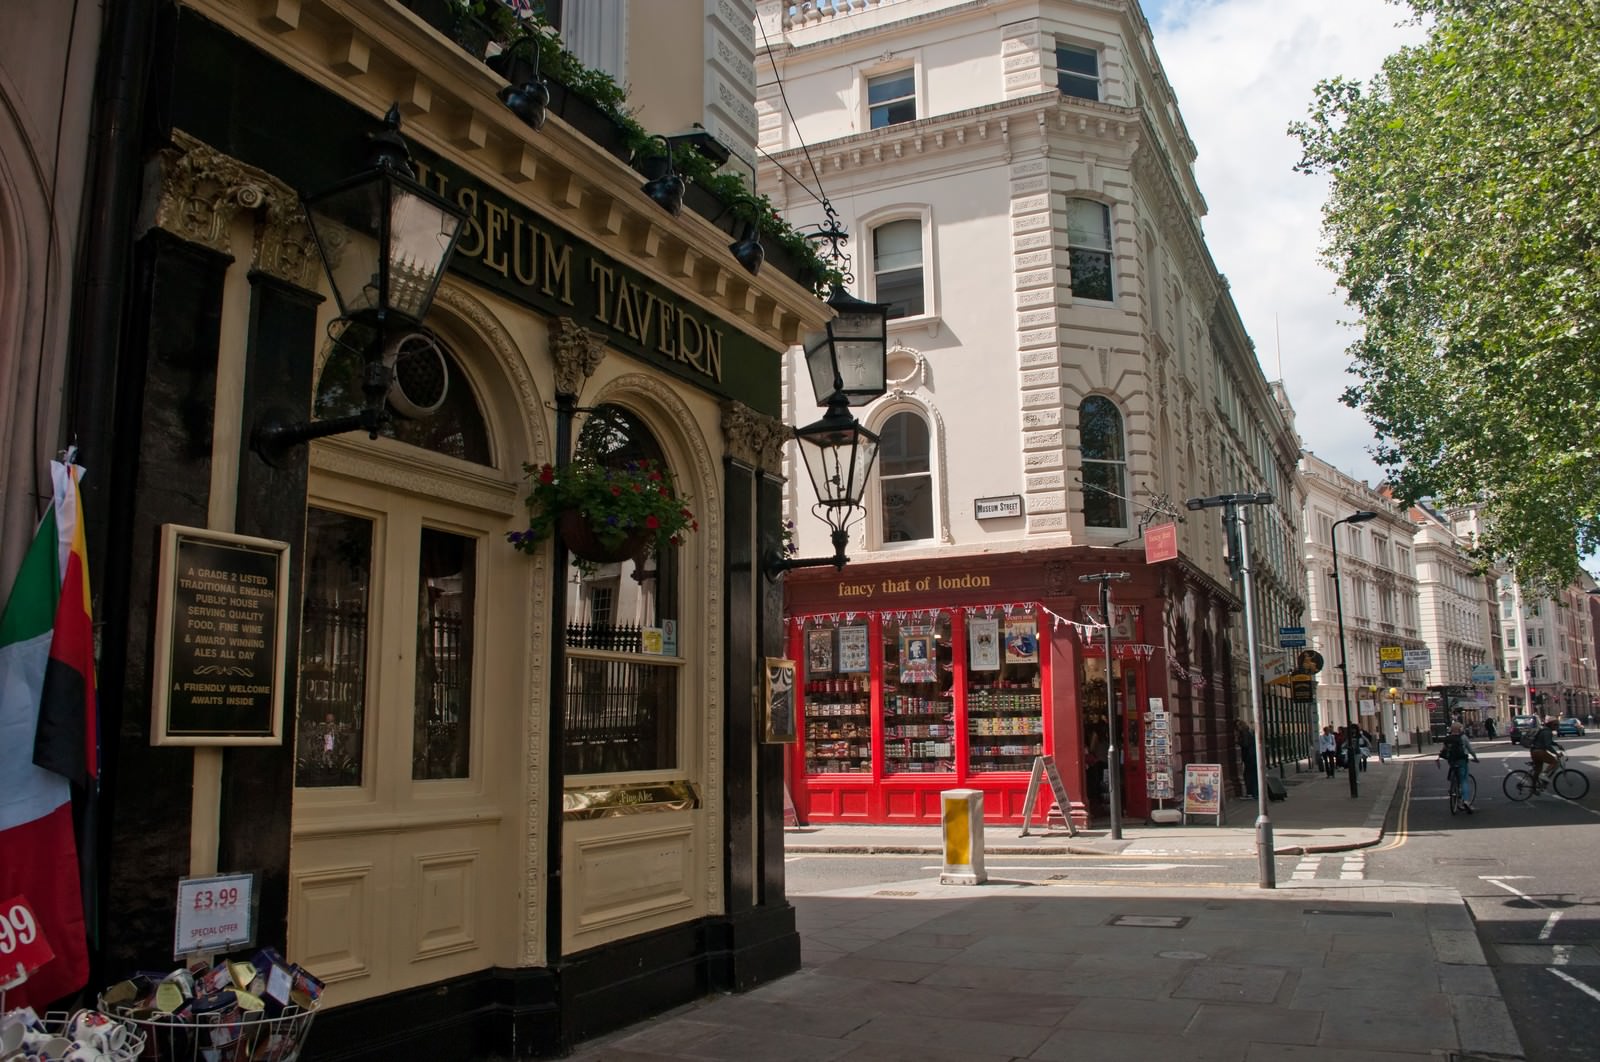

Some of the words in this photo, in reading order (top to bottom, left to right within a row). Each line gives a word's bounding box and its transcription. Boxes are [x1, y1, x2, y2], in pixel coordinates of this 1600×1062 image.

[411, 160, 575, 306] SEUM
[591, 257, 723, 383] TAVERN
[188, 567, 194, 576] A
[198, 568, 229, 579] GRADE
[231, 573, 237, 582] 2
[240, 574, 268, 585] LISTED
[180, 579, 237, 594] TRADITIONAL
[240, 586, 274, 599] ENGLISH
[838, 582, 875, 598] fancy
[882, 579, 911, 593] that
[915, 576, 931, 591] of
[938, 573, 991, 590] london
[195, 593, 227, 606] PUBLIC
[229, 597, 259, 609] HOUSE
[188, 606, 226, 618] SERVING
[229, 610, 264, 621] QUALITY
[188, 620, 216, 632] FOOD,
[219, 622, 239, 632] FINE
[242, 624, 263, 634] WINE
[184, 633, 191, 643] &
[195, 634, 226, 646] AWARD
[229, 637, 265, 649] WINNING
[194, 648, 217, 657] ALES
[220, 650, 236, 659] ALL
[238, 651, 256, 660] DAY
[173, 682, 180, 691] A
[183, 682, 226, 692] FRIENDLY
[229, 684, 271, 694] WELCOME
[191, 696, 223, 705] AWAITS
[226, 697, 255, 706] INSIDE
[193, 887, 238, 909] £3.99
[191, 926, 217, 938] SPECIAL
[219, 923, 238, 934] OFFER
